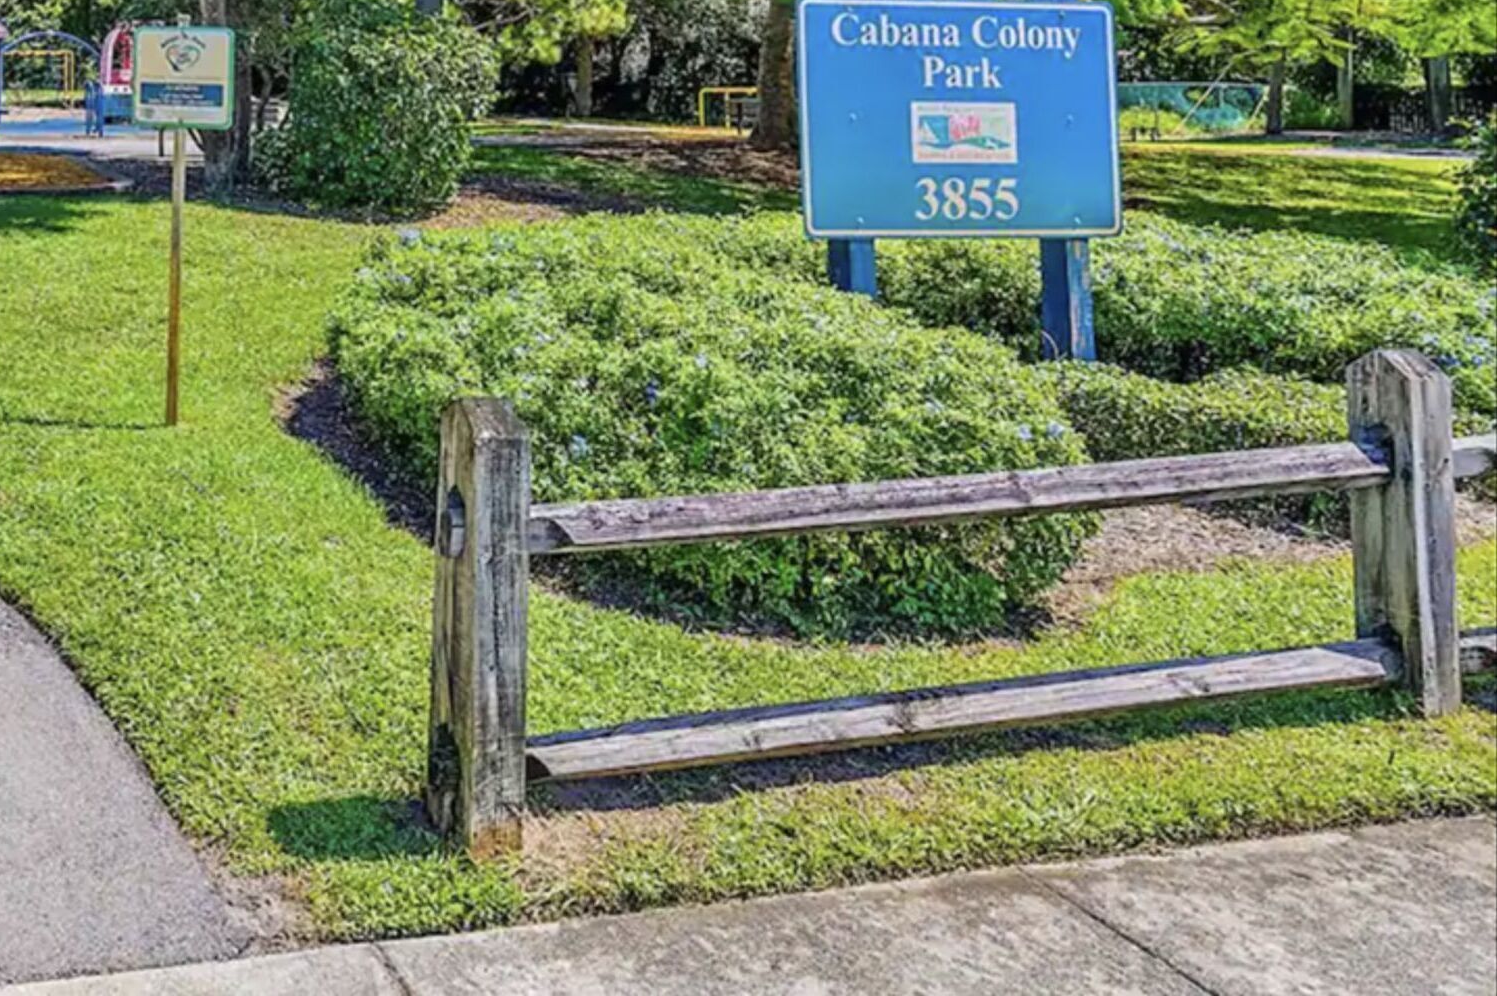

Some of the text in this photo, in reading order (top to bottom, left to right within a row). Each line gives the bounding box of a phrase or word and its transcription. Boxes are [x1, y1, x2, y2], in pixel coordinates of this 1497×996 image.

[831, 11, 1081, 59] Cabana Colony
[922, 54, 1003, 89] Park
[915, 177, 1019, 221] 3855
